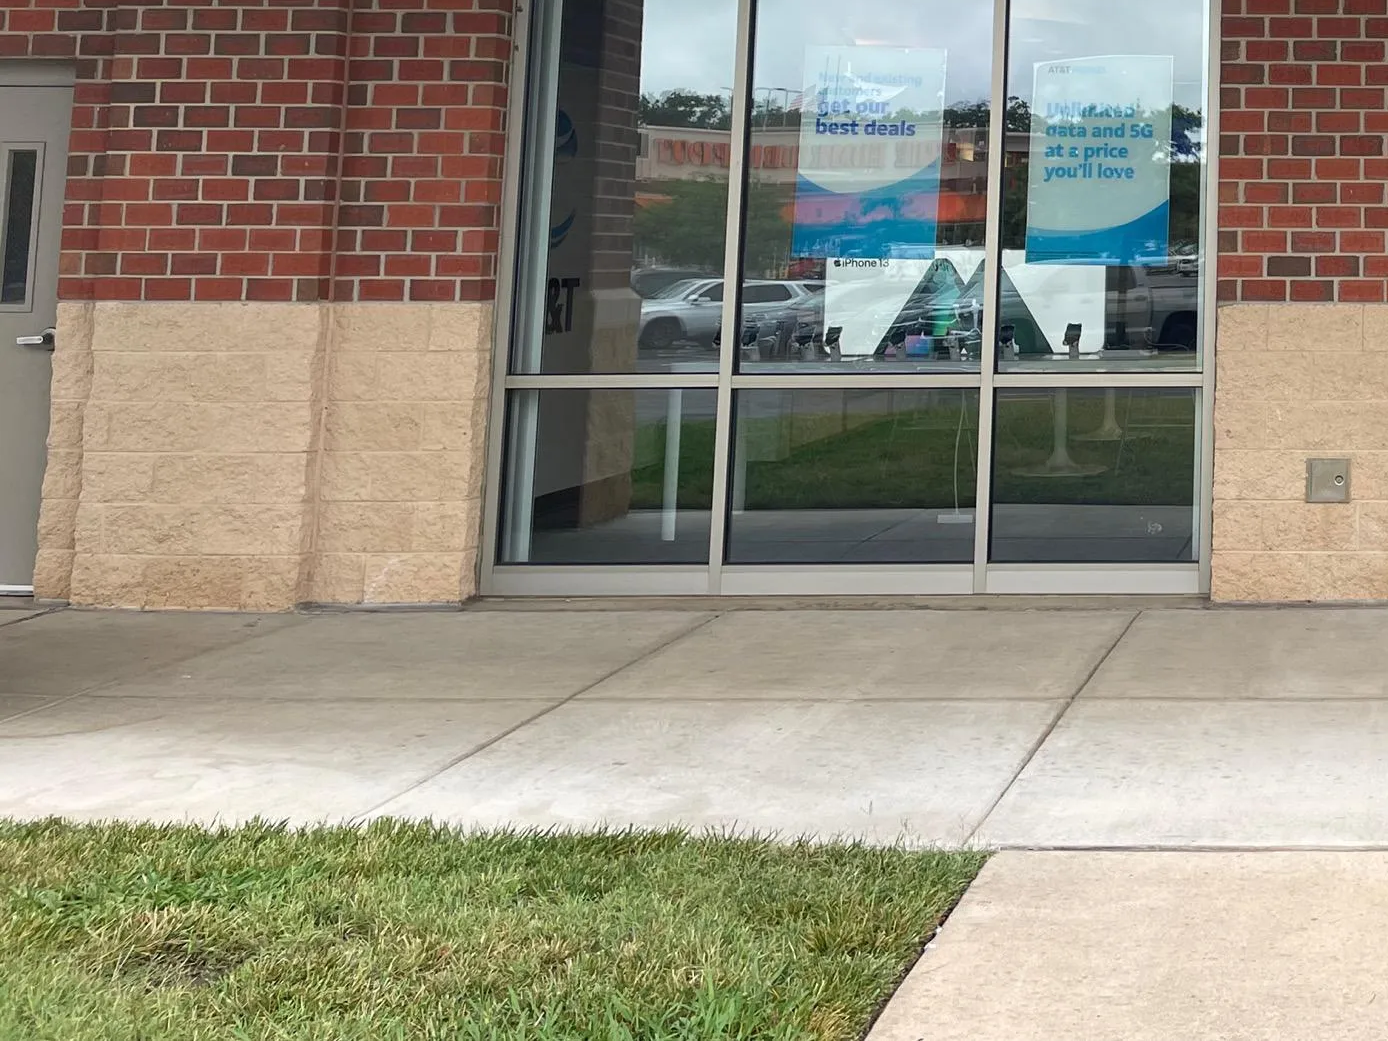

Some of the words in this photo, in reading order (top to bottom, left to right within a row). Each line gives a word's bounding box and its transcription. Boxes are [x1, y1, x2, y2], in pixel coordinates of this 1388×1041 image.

[817, 97, 851, 117] get
[856, 99, 890, 114] our
[815, 118, 859, 135] best
[864, 119, 916, 137] deals
[1045, 123, 1087, 138] data
[1092, 123, 1125, 138] and
[1130, 123, 1154, 138] 5G
[1044, 144, 1064, 158] at
[1069, 146, 1079, 158] a
[1084, 143, 1129, 162] price
[1043, 163, 1093, 182] you'll
[1098, 163, 1135, 179] love
[842, 259, 877, 268] iPhone
[879, 258, 890, 268] 13
